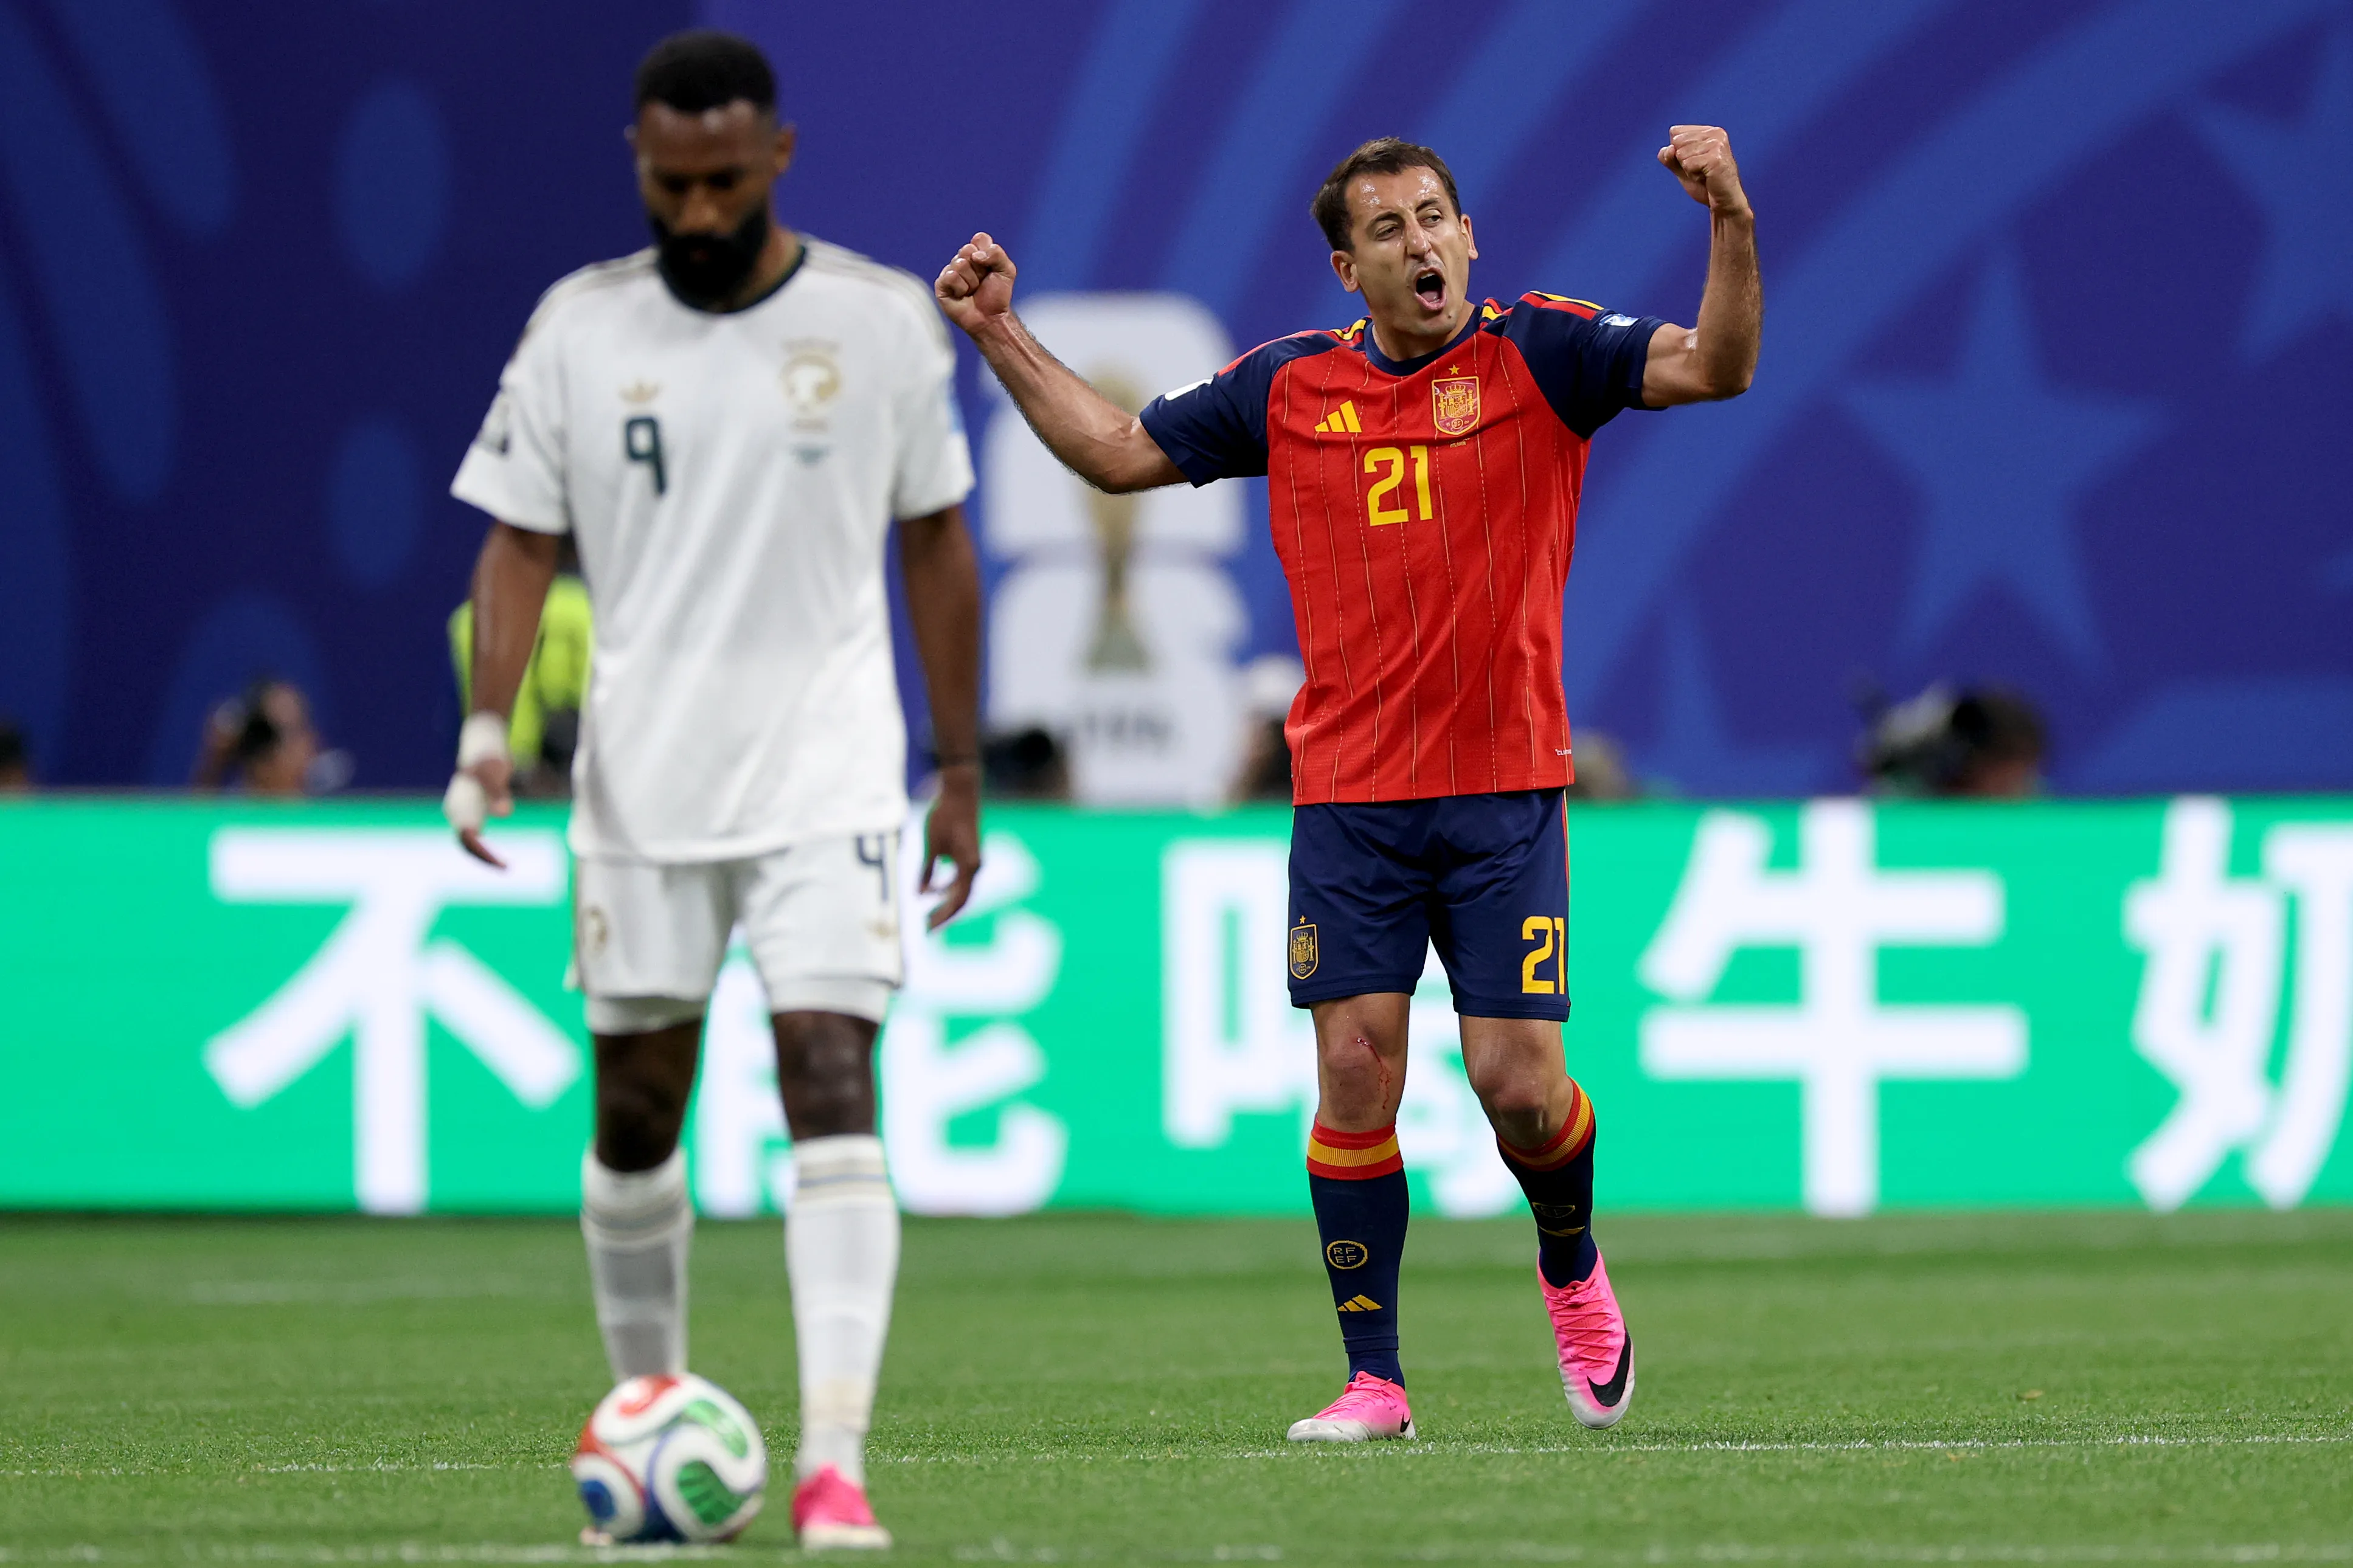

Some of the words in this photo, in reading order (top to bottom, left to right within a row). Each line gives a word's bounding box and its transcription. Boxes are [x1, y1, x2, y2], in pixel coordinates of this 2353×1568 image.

[626, 417, 667, 496] 9
[1364, 446, 1433, 527] 21
[1522, 916, 1565, 995] 21
